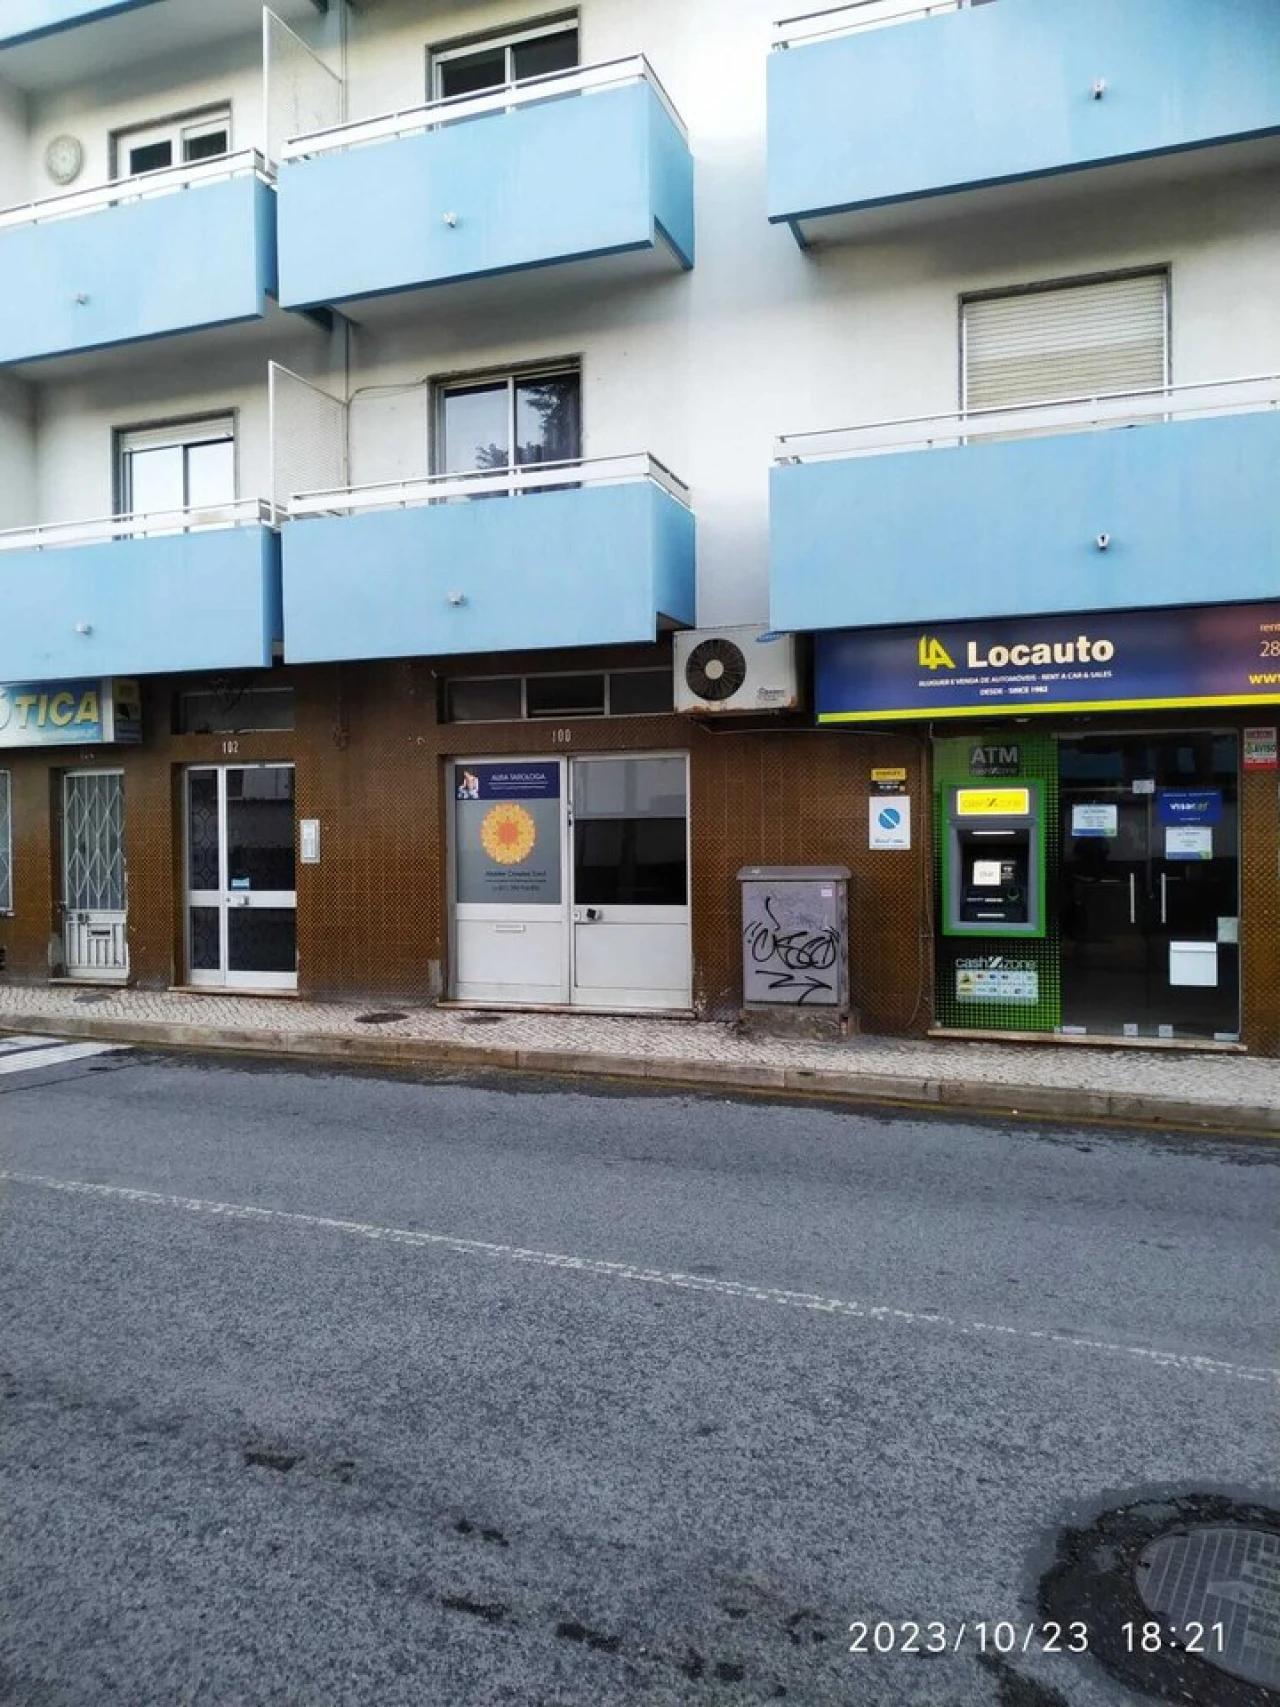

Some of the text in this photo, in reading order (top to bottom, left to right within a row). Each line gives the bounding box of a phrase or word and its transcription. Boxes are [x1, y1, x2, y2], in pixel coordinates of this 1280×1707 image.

[967, 635, 1115, 668] Locauto
[552, 728, 571, 744] 100
[222, 740, 239, 755] 102
[970, 746, 1018, 764] ATM
